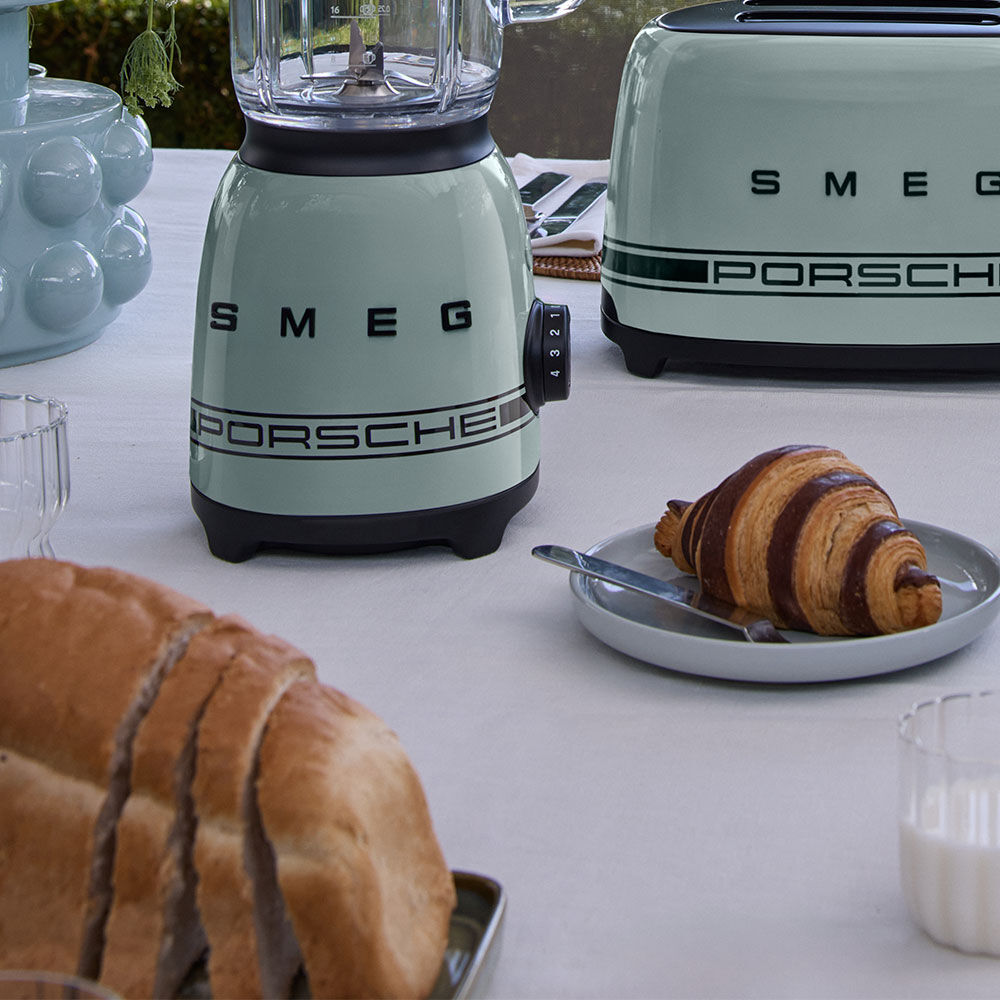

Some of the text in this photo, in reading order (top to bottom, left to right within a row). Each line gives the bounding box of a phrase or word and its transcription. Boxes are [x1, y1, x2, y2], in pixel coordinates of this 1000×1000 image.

[330, 5, 340, 14] 16
[210, 300, 472, 339] SMEG
[549, 349, 560, 357] 3
[198, 406, 497, 450] PORSCHE
